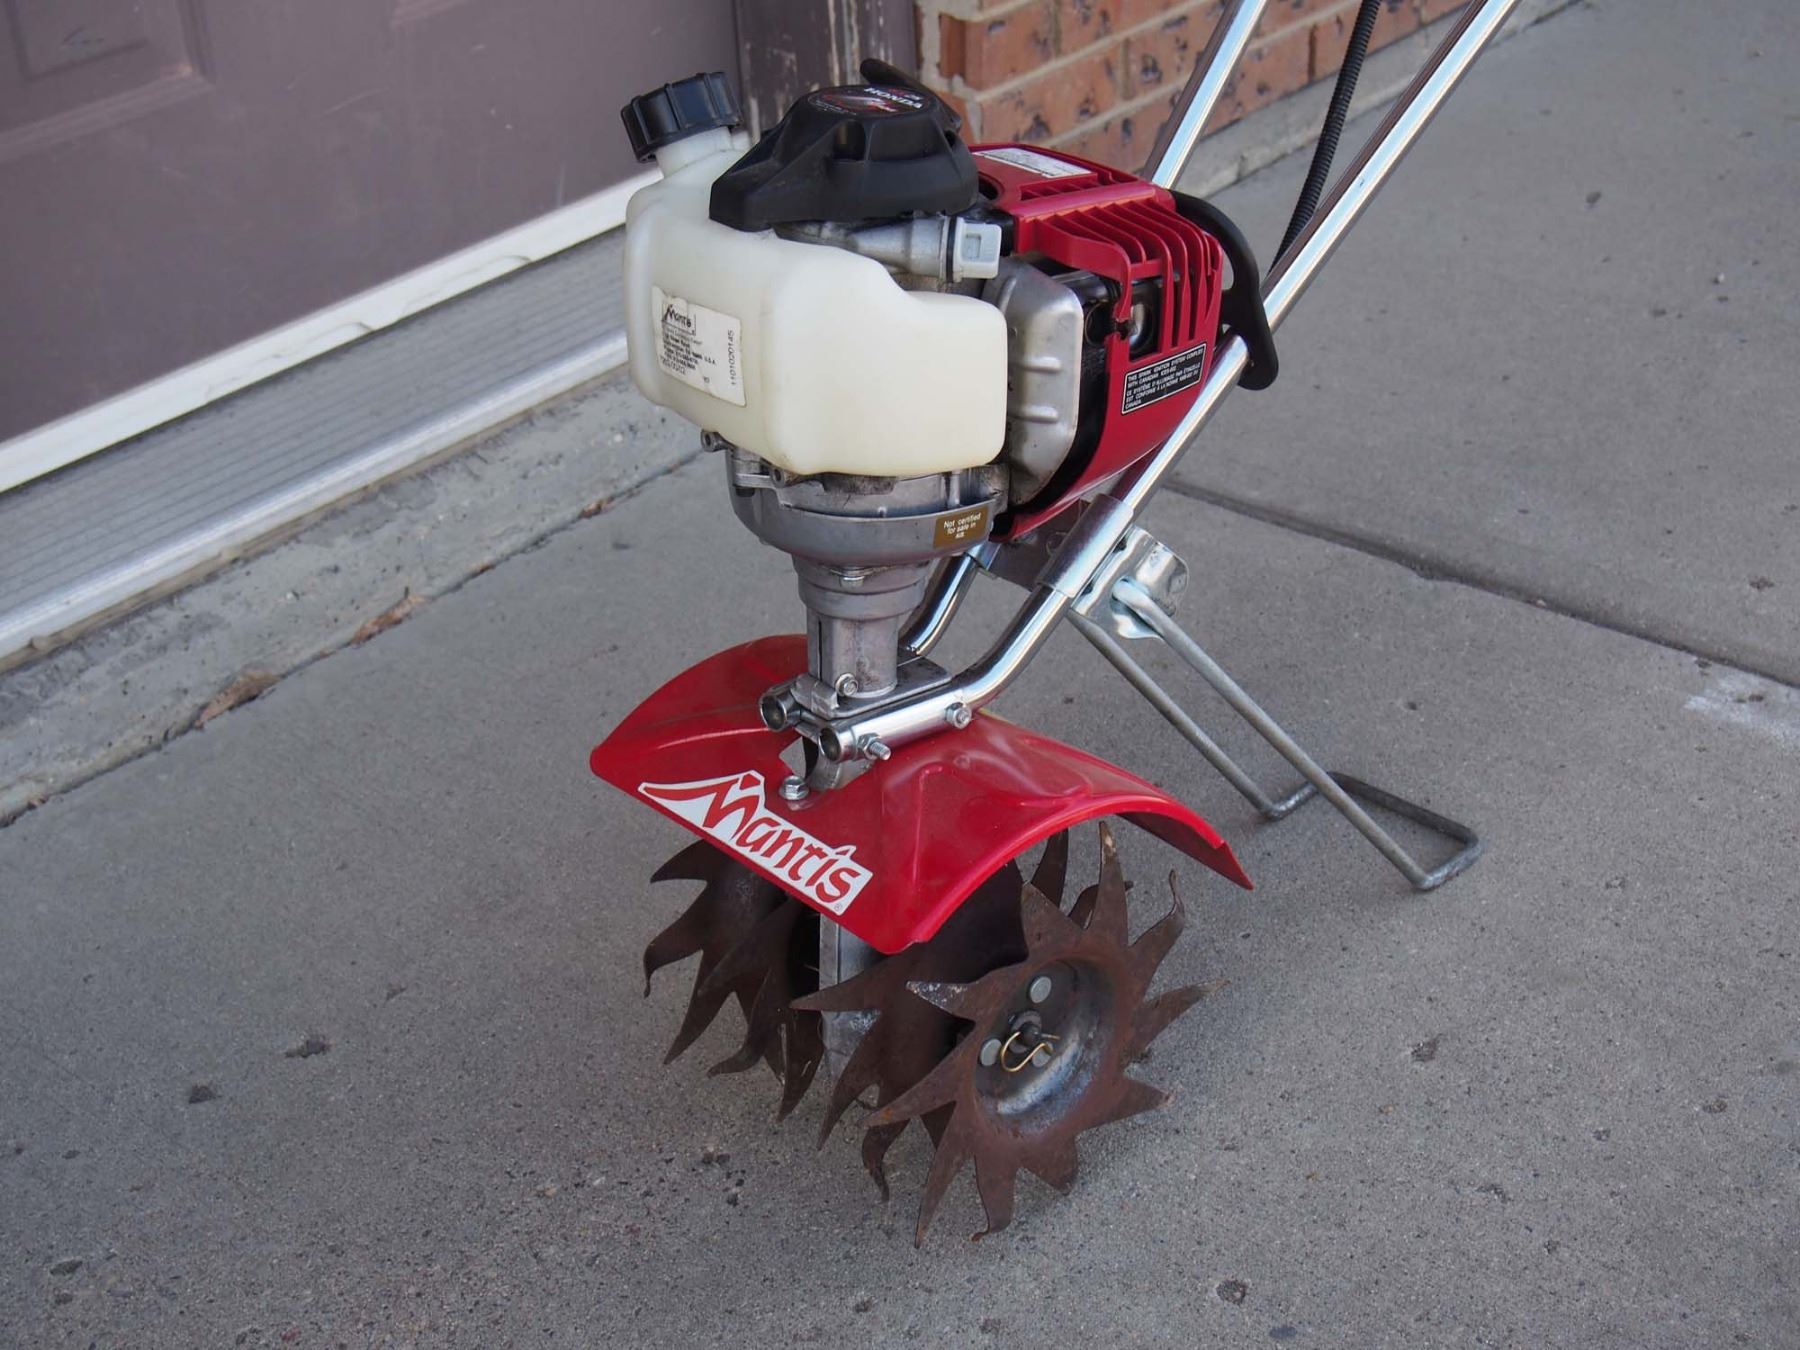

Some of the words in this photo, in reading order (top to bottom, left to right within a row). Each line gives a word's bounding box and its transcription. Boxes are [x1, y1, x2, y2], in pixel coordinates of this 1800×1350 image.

[864, 87, 922, 109] HONDA
[1171, 356, 1186, 365] SYSTEM
[1139, 373, 1159, 384] CANADIAN
[1125, 400, 1141, 409] CANADA
[944, 520, 955, 529] Not
[958, 512, 981, 525] certified
[947, 527, 955, 535] for
[957, 524, 969, 532] sale
[643, 772, 861, 903] Mantis
